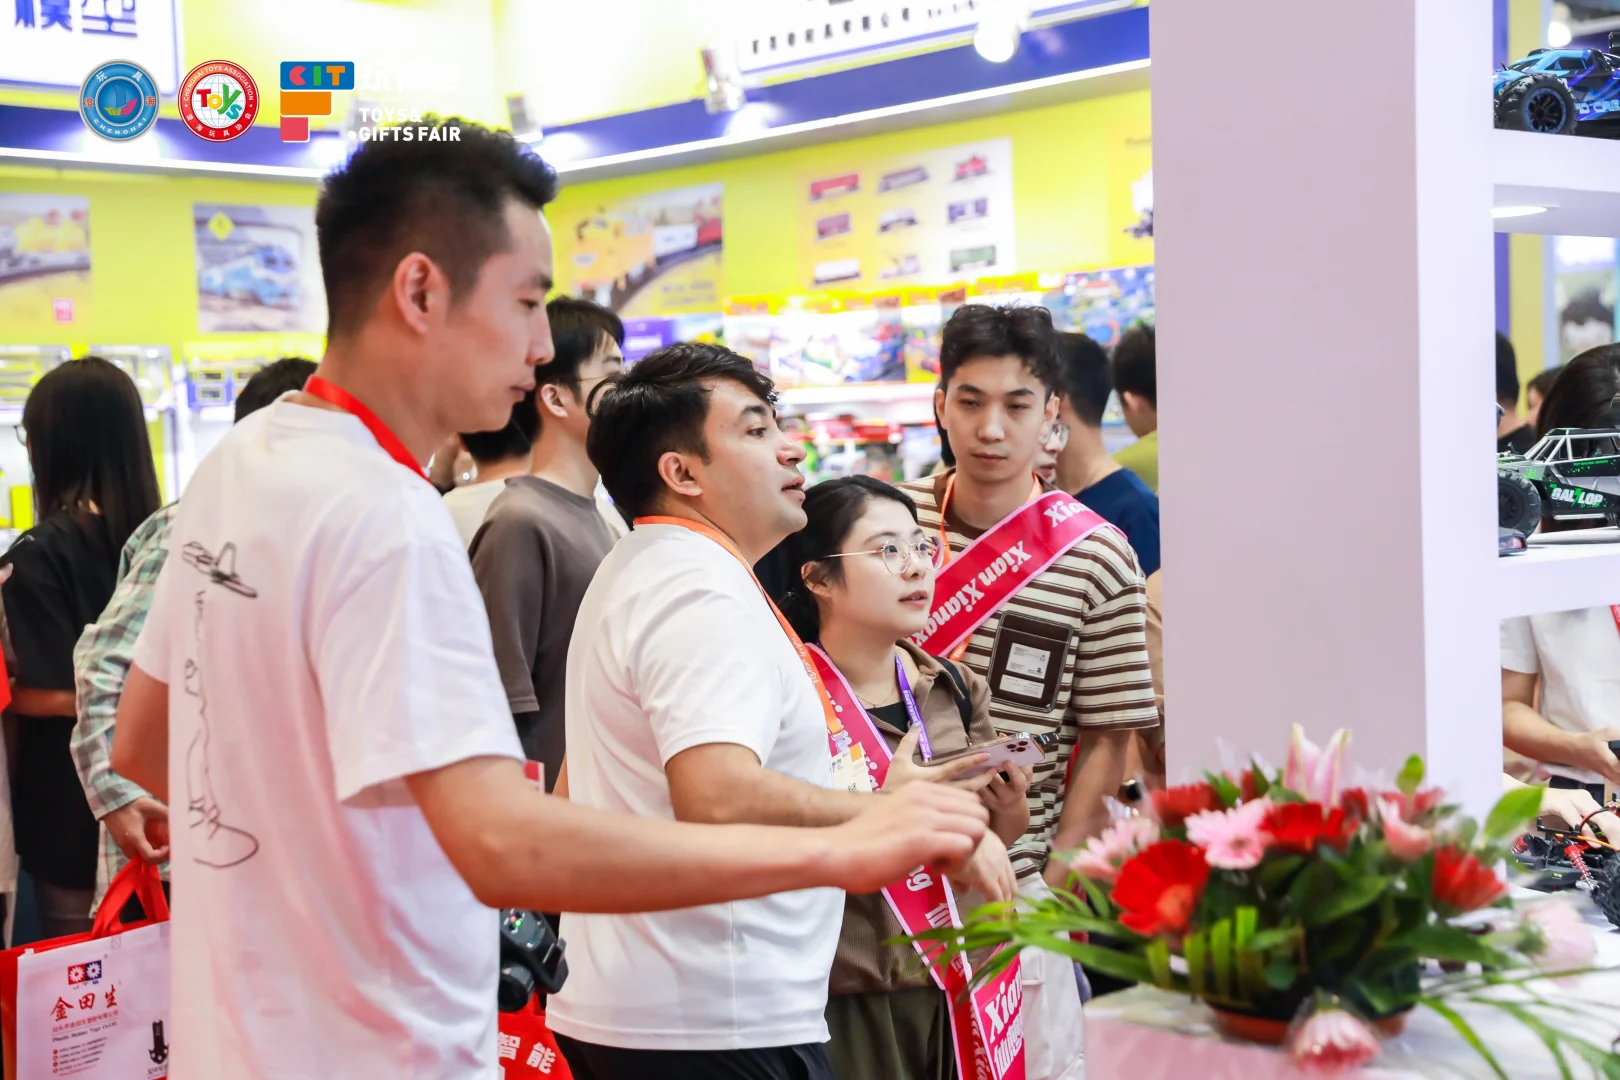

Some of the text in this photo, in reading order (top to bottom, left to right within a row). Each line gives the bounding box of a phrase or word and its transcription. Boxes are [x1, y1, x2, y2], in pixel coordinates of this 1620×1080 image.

[909, 540, 1032, 647] Xian Xiangx
[50, 984, 117, 1022] 金田生
